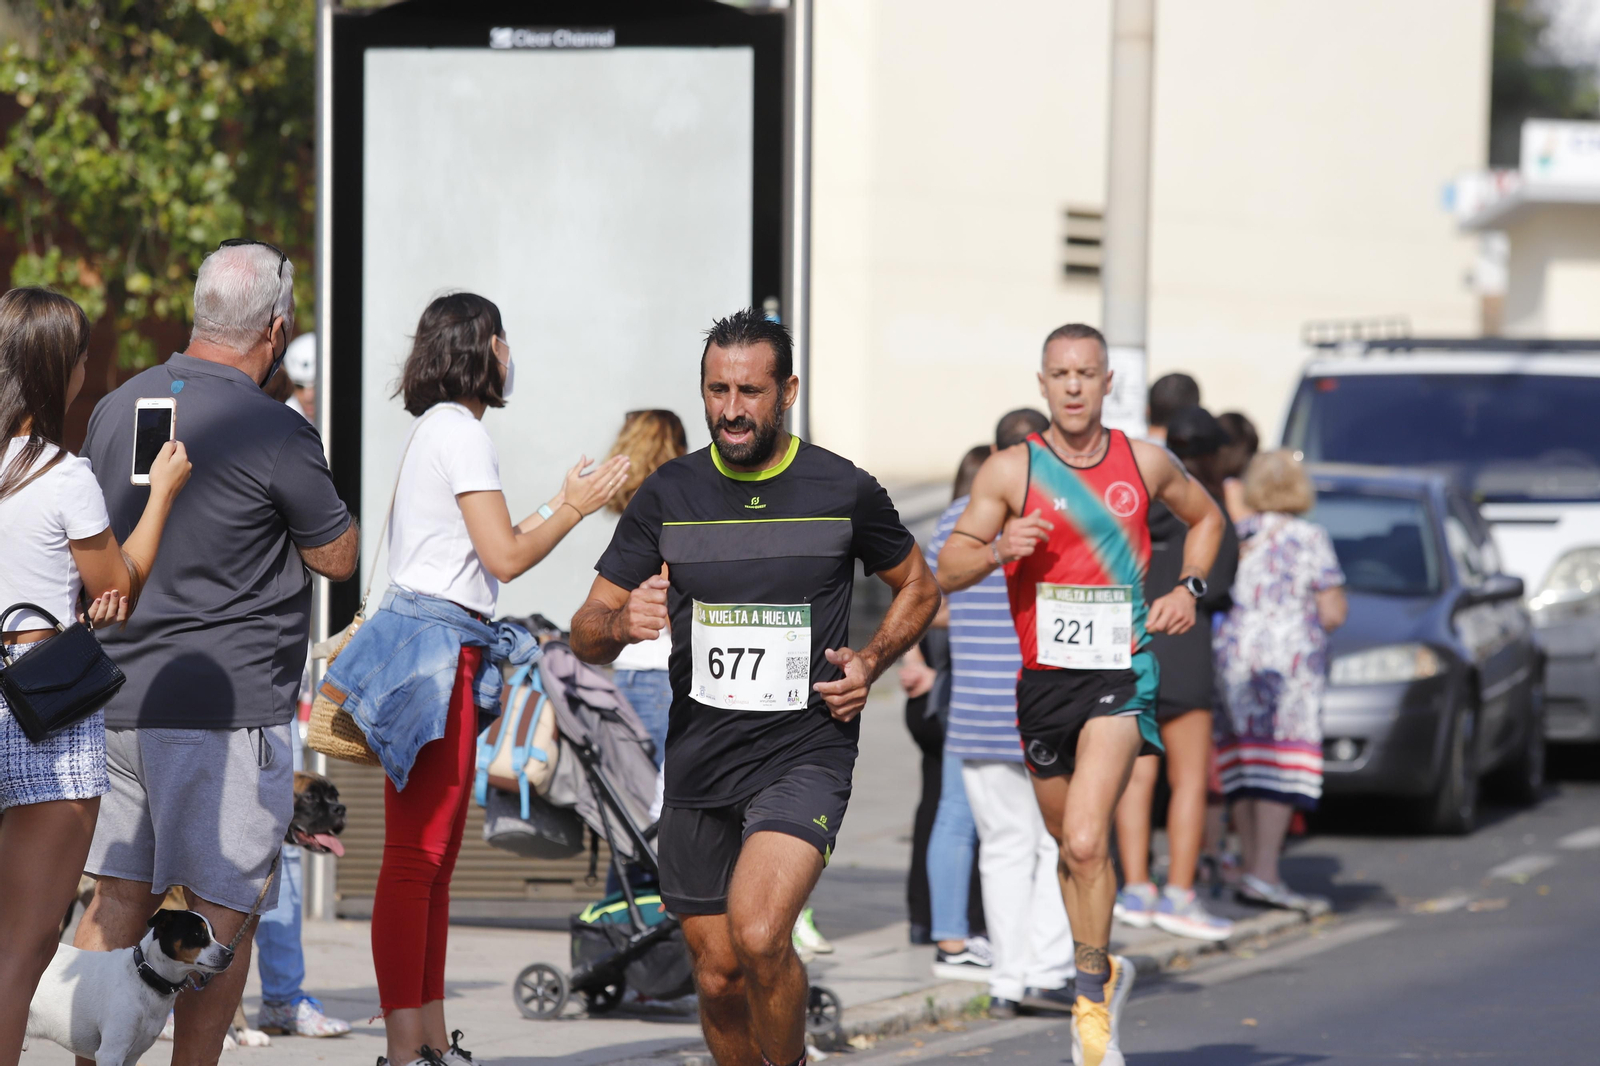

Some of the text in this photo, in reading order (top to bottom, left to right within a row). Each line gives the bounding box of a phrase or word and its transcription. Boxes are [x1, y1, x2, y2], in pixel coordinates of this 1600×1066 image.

[514, 29, 615, 47] Clear Channel
[708, 610, 748, 624] VUELTA
[751, 610, 759, 624] A
[762, 610, 802, 625] HUELVA
[1053, 618, 1093, 645] 221
[708, 647, 766, 680] 677
